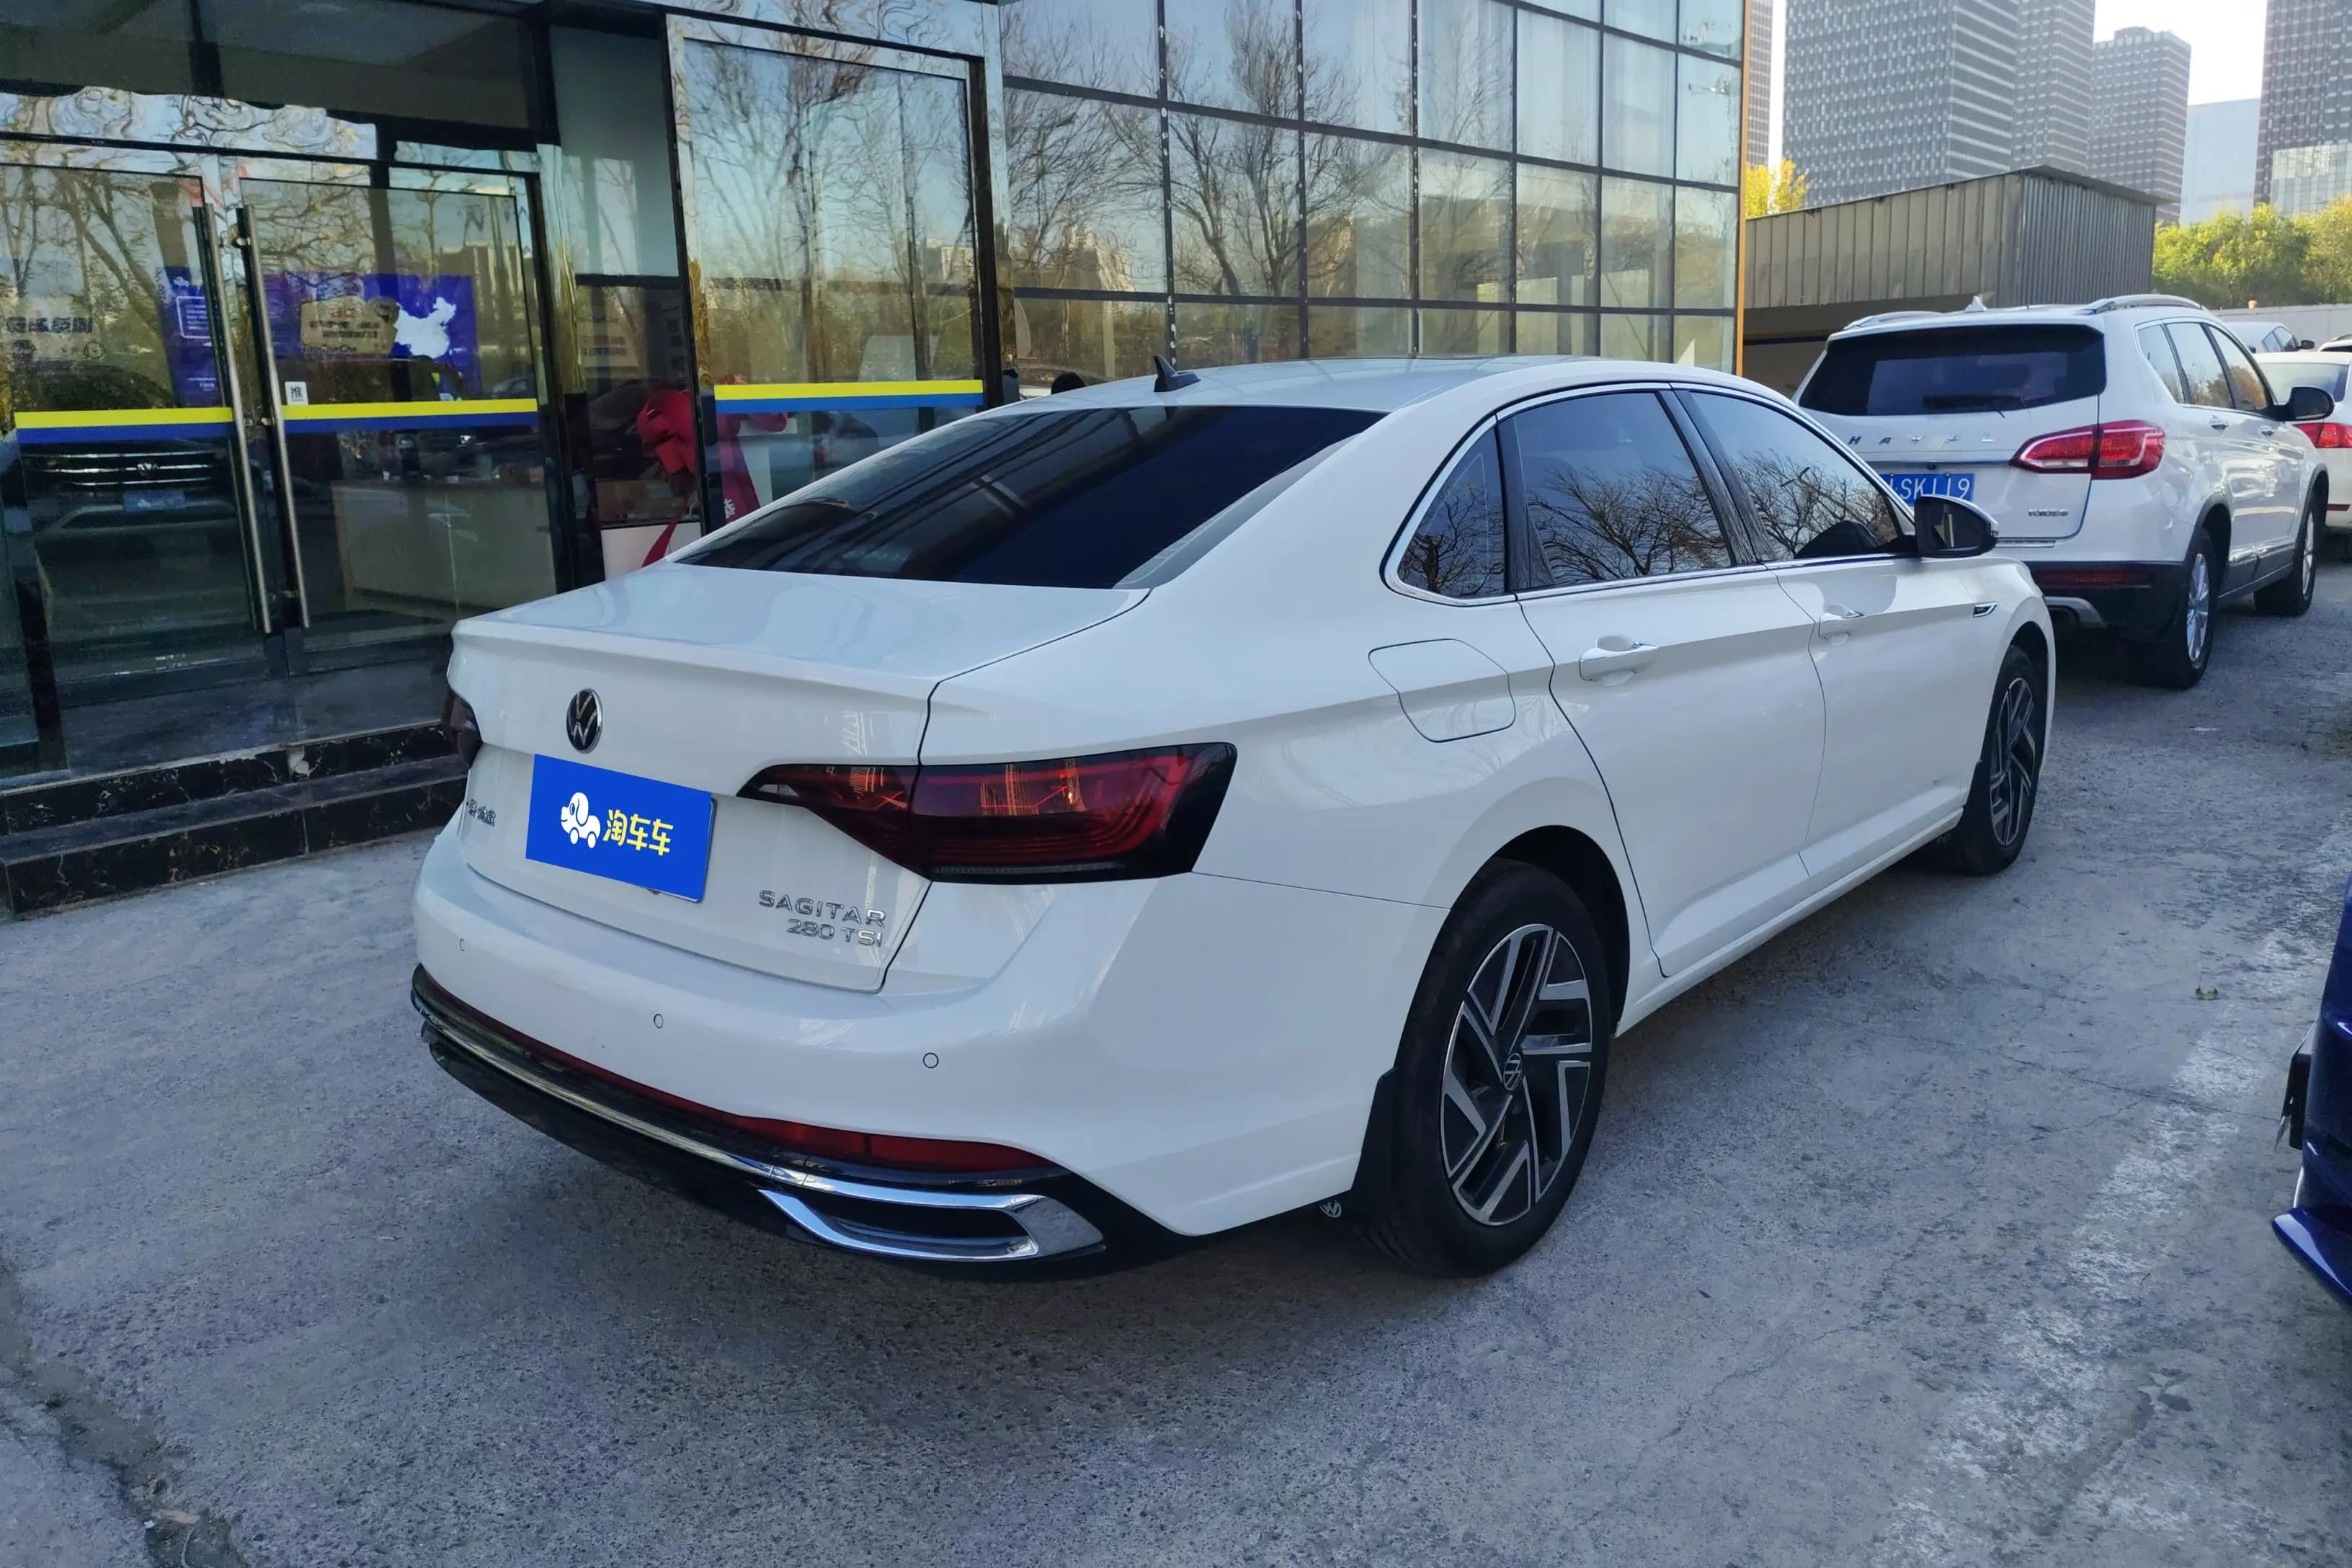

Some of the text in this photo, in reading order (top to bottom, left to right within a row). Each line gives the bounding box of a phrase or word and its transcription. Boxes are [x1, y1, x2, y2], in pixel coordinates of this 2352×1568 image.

[290, 386, 303, 398] 推
[1848, 433, 1995, 445] HAVAL
[759, 889, 886, 928] SAGITAR
[787, 918, 883, 948] 280 TSI
